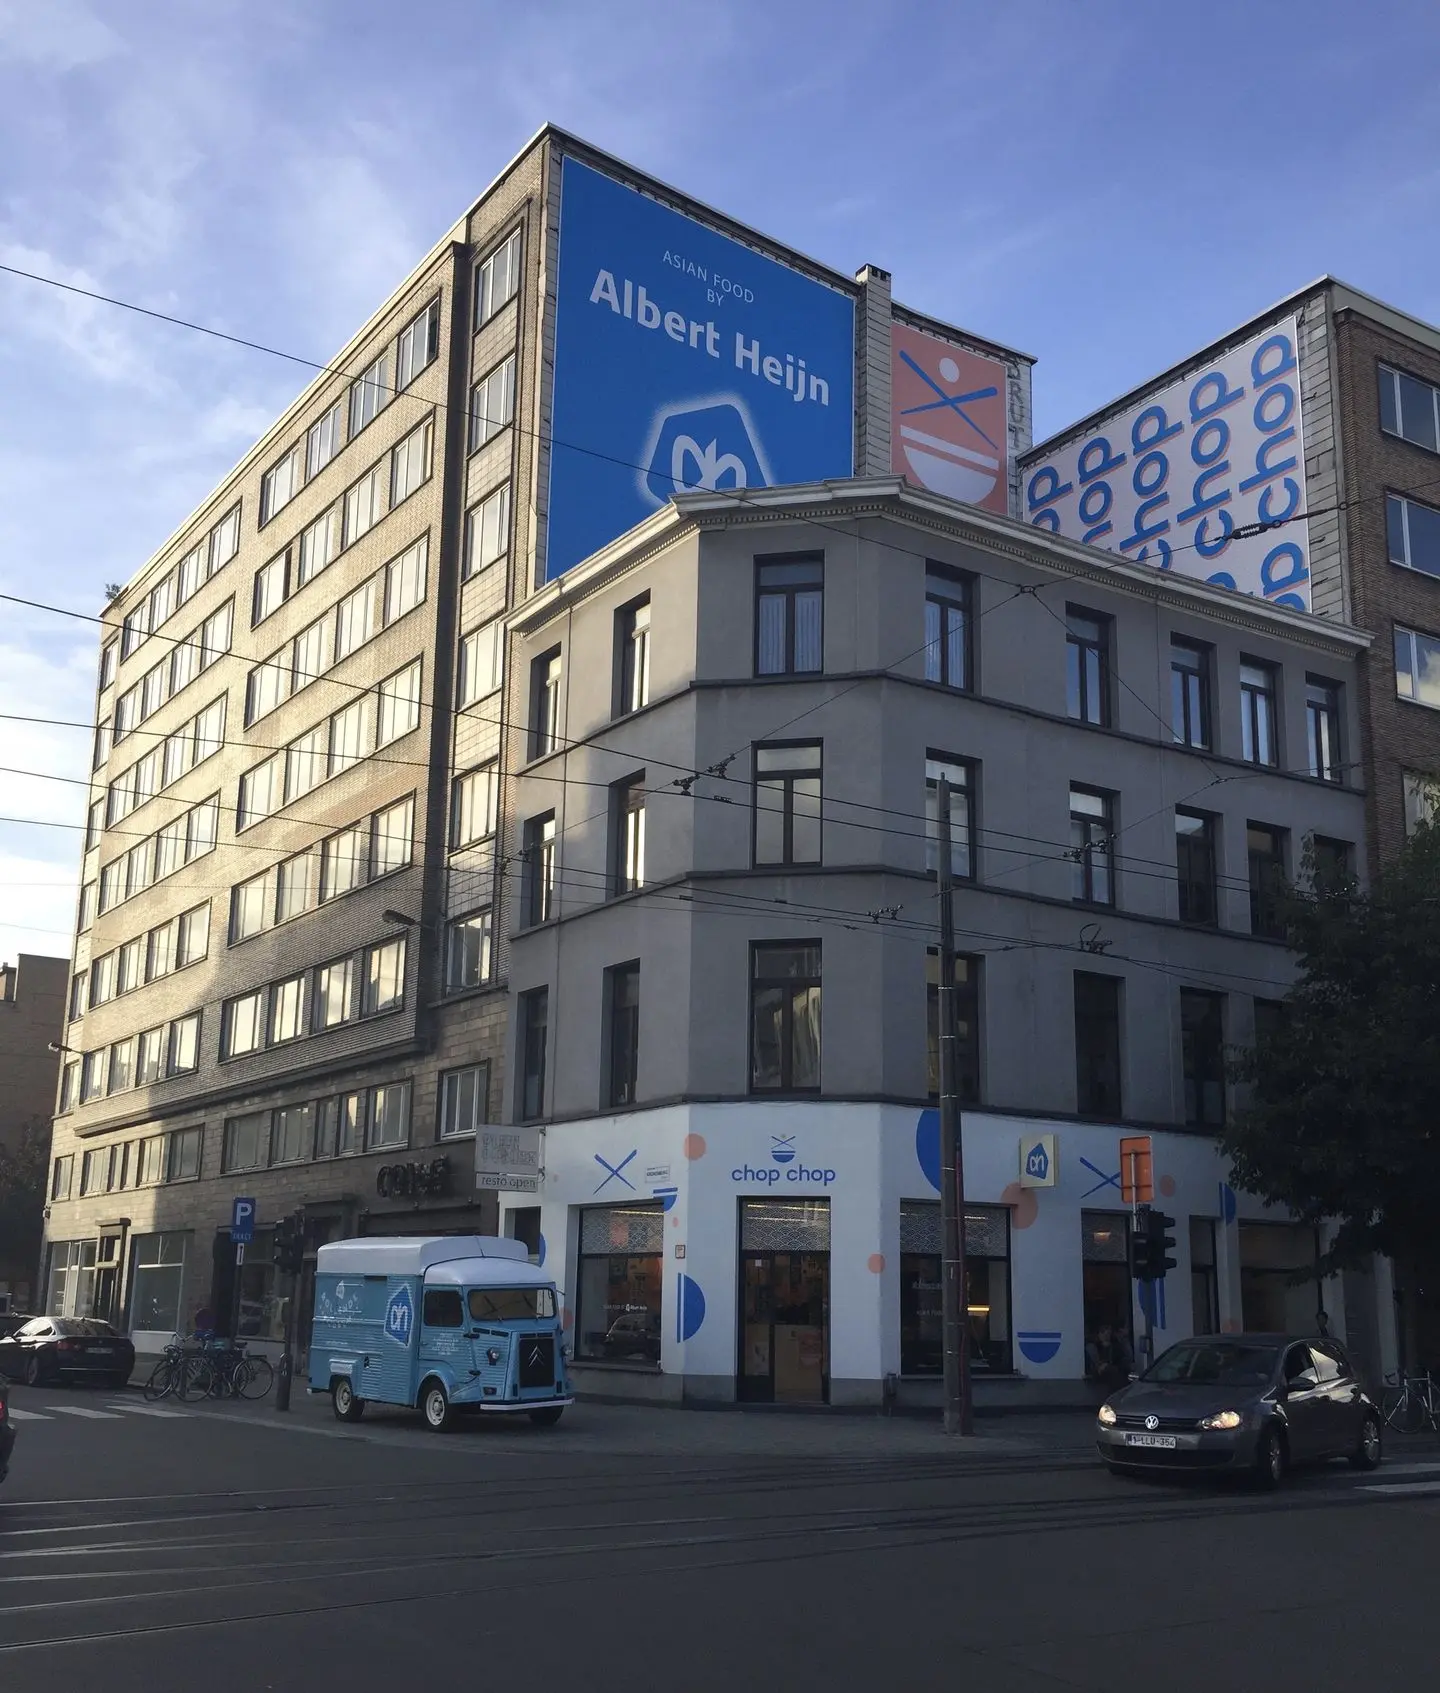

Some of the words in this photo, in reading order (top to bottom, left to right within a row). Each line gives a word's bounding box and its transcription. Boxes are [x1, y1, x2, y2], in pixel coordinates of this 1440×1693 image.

[662, 250, 708, 282] ASIAN
[713, 273, 754, 304] FOOD
[707, 288, 723, 307] BY
[589, 269, 720, 358] Albert
[735, 333, 830, 406] Heijn
[1239, 334, 1300, 525] chop
[1177, 371, 1245, 557] chop
[510, 1179, 536, 1189] open
[731, 1164, 780, 1186] chop
[786, 1164, 836, 1186] chop
[235, 1202, 252, 1226] P
